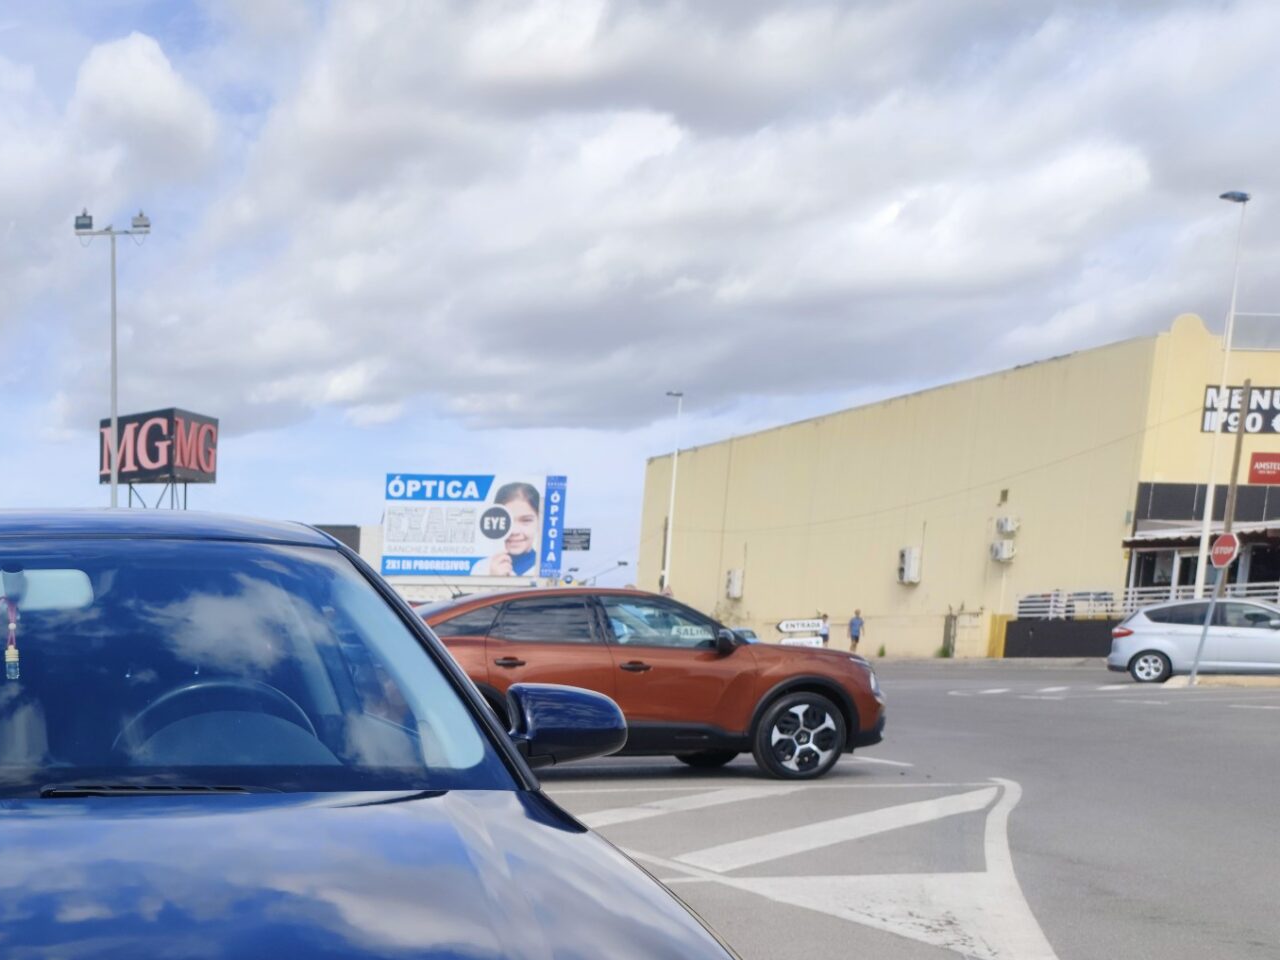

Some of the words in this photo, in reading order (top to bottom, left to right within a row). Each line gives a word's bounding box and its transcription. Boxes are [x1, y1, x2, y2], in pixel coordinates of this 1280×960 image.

[100, 417, 172, 475] MG
[174, 416, 217, 473] MG
[388, 476, 480, 498] ÓPTICA
[484, 517, 506, 530] EYE
[1214, 546, 1234, 554] STOP
[401, 560, 412, 569] EN
[413, 560, 471, 570] PROGRESIVOS
